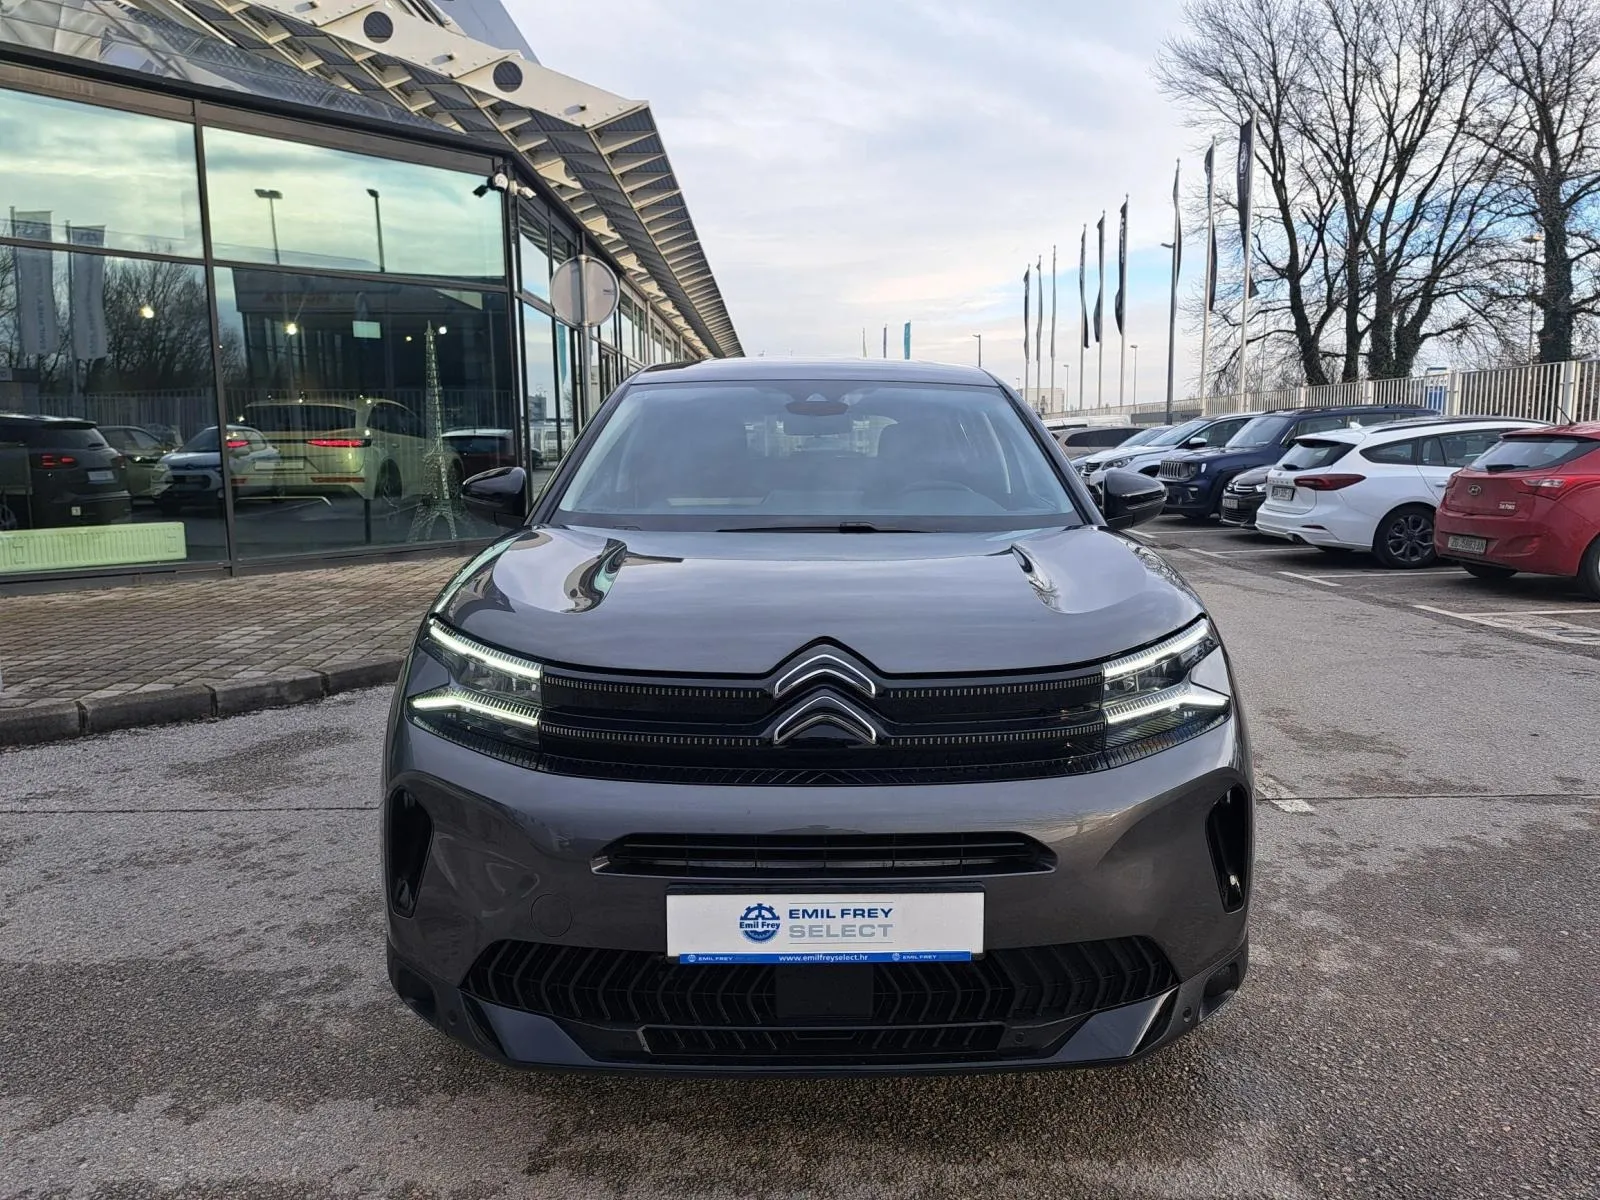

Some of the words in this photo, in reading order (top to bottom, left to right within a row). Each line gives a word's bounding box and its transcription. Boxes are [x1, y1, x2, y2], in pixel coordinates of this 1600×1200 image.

[788, 908, 837, 920] EMIL
[840, 908, 894, 919] FREY
[739, 921, 759, 929] Emil
[761, 921, 781, 930] Frey
[788, 924, 894, 939] SELECT
[778, 953, 868, 962] www.emilfreyselect.hr
